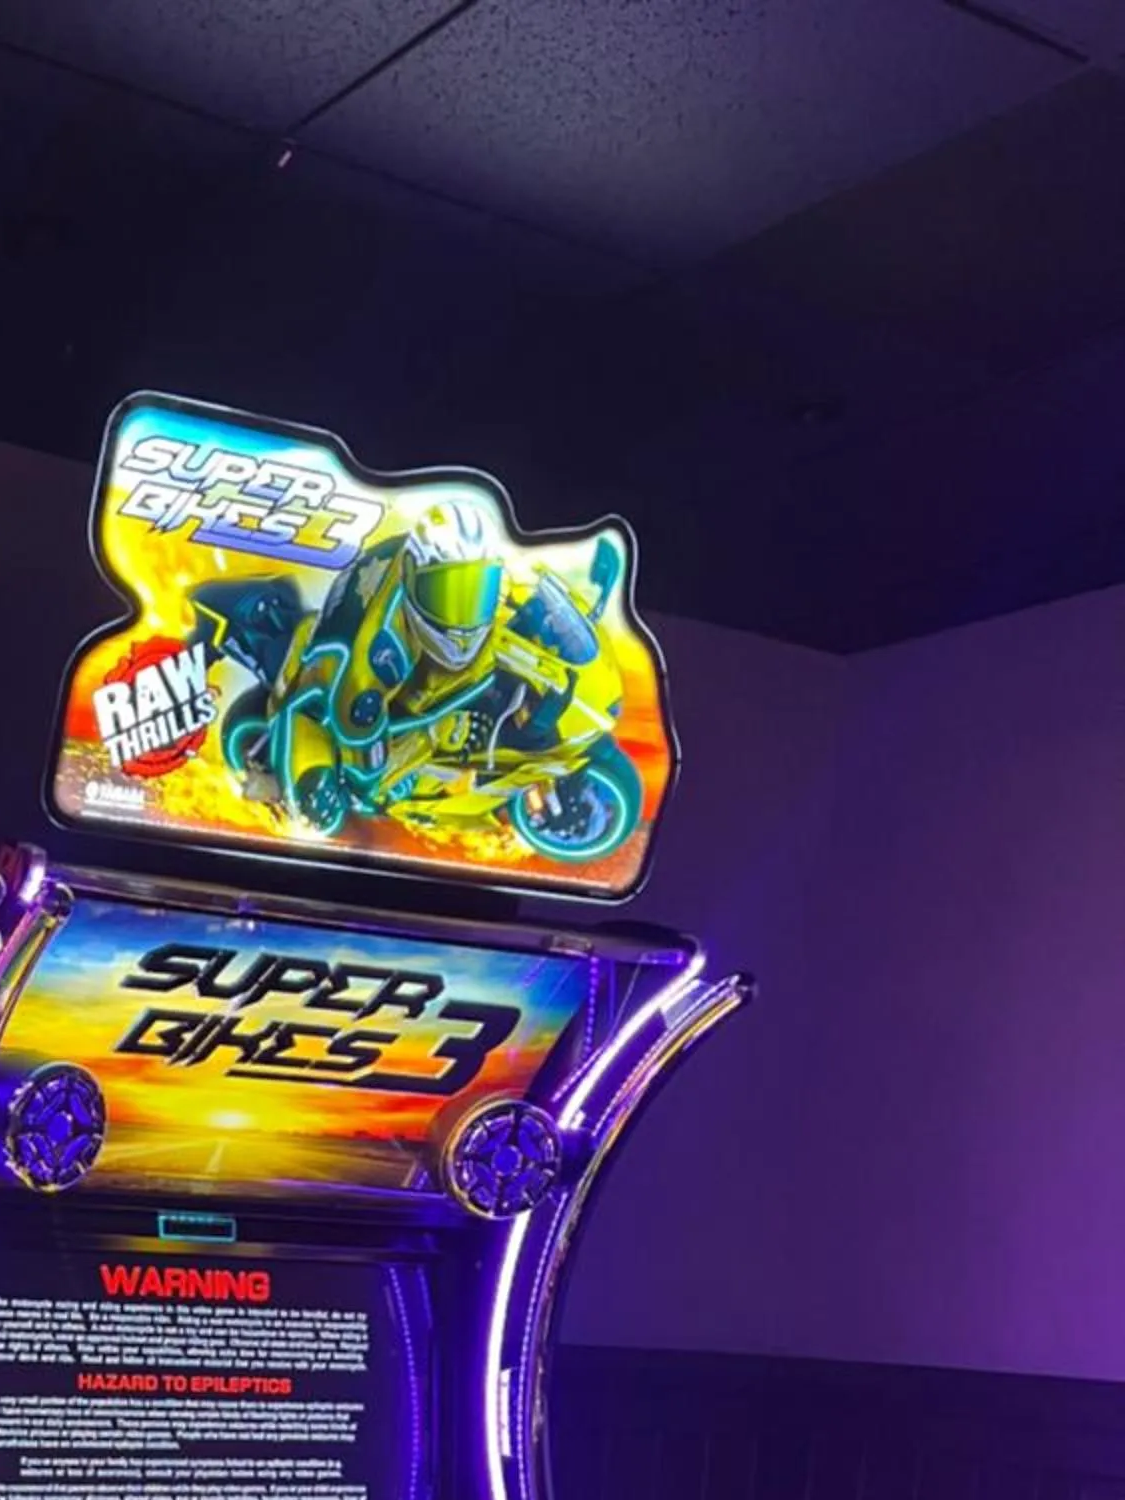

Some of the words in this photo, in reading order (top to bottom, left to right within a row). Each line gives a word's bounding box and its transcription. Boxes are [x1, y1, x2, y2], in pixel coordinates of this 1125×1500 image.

[119, 434, 337, 512] SUPER
[116, 480, 313, 546] BIKES
[93, 641, 206, 740] RAW
[103, 693, 218, 768] THRILLS
[120, 943, 445, 1021] SUPER
[114, 1008, 399, 1070] BIKES
[100, 1264, 271, 1302] WARNING
[78, 1373, 159, 1392] HAZARD
[162, 1374, 188, 1392] TO
[190, 1376, 292, 1394] EPILEPTICS
